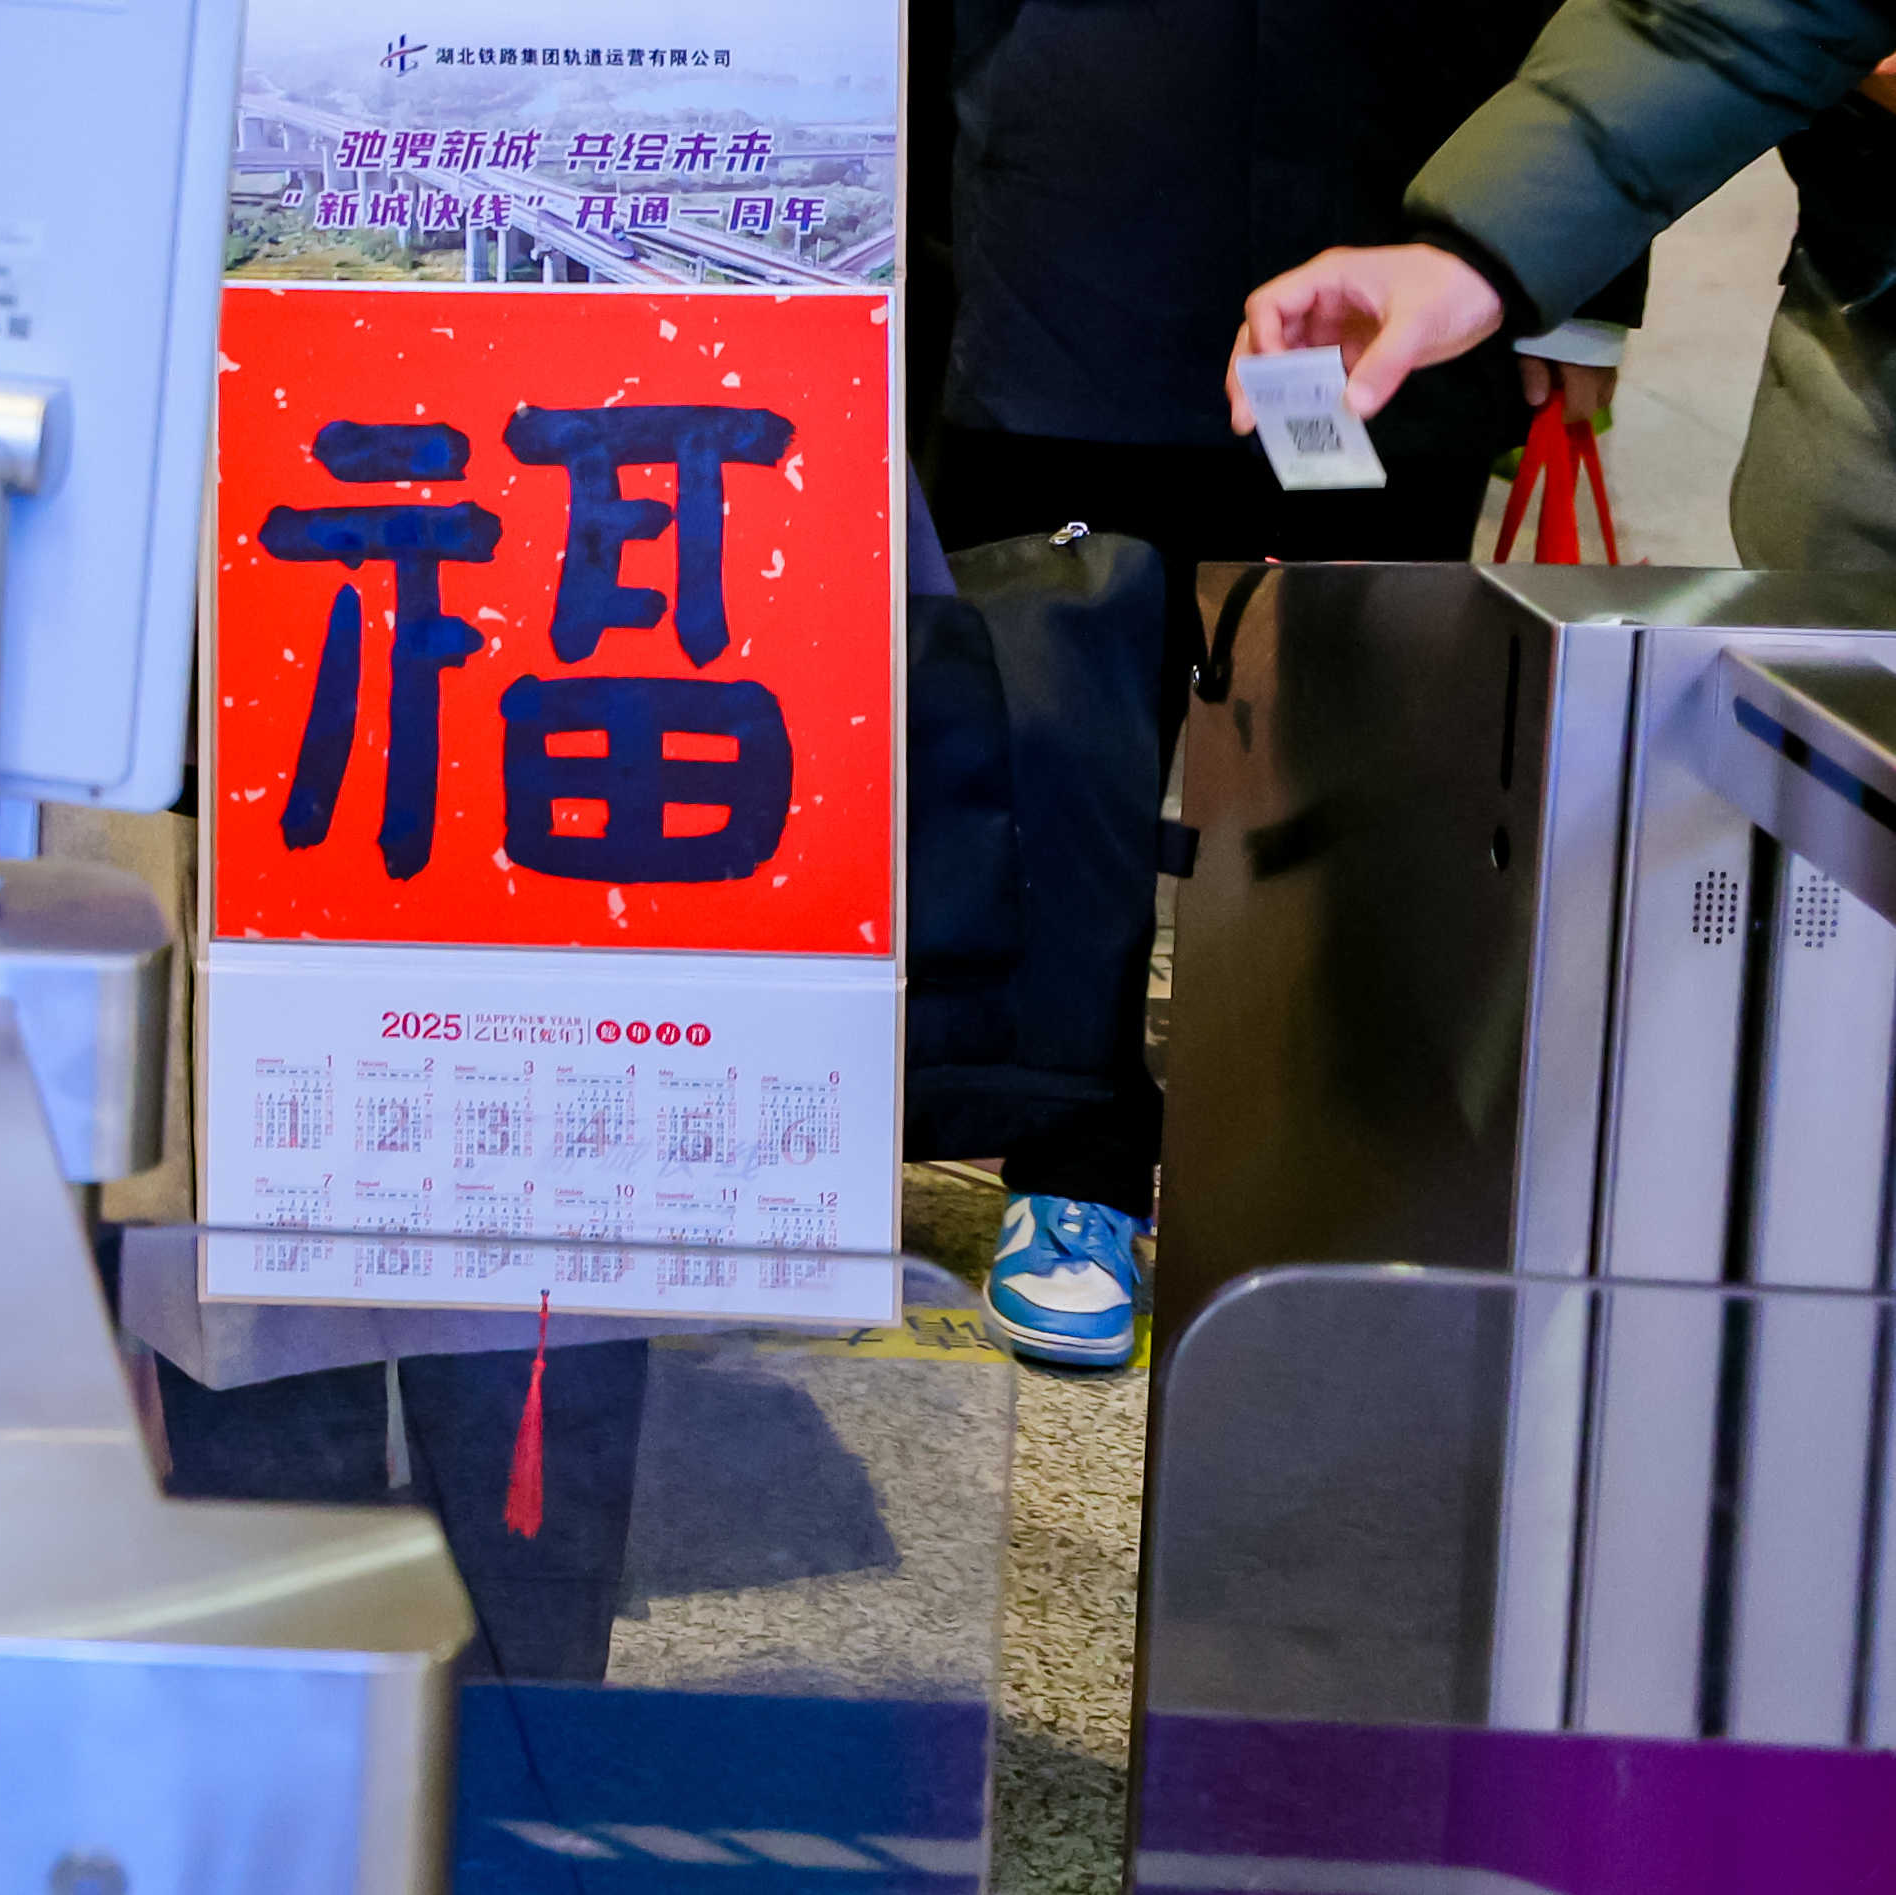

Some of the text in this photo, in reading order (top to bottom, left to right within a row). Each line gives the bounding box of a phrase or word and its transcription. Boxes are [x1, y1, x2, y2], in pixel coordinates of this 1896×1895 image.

[434, 47, 732, 70] 湖北铁路集团轨道运营有限公司
[335, 128, 774, 174] 驰骋新城 共绘未来
[259, 406, 794, 883] 福
[380, 1010, 463, 1041] 2025
[325, 1055, 333, 1068] 1
[423, 1057, 435, 1072] 2
[523, 1060, 535, 1075] 3
[625, 1064, 636, 1077] 4
[727, 1066, 738, 1081] 5
[828, 1071, 841, 1085] 6
[322, 1174, 333, 1189] 7
[421, 1177, 433, 1192] 8
[523, 1180, 535, 1195] 9
[614, 1184, 635, 1199] 10
[720, 1188, 739, 1202] 11
[817, 1191, 839, 1206] 12
